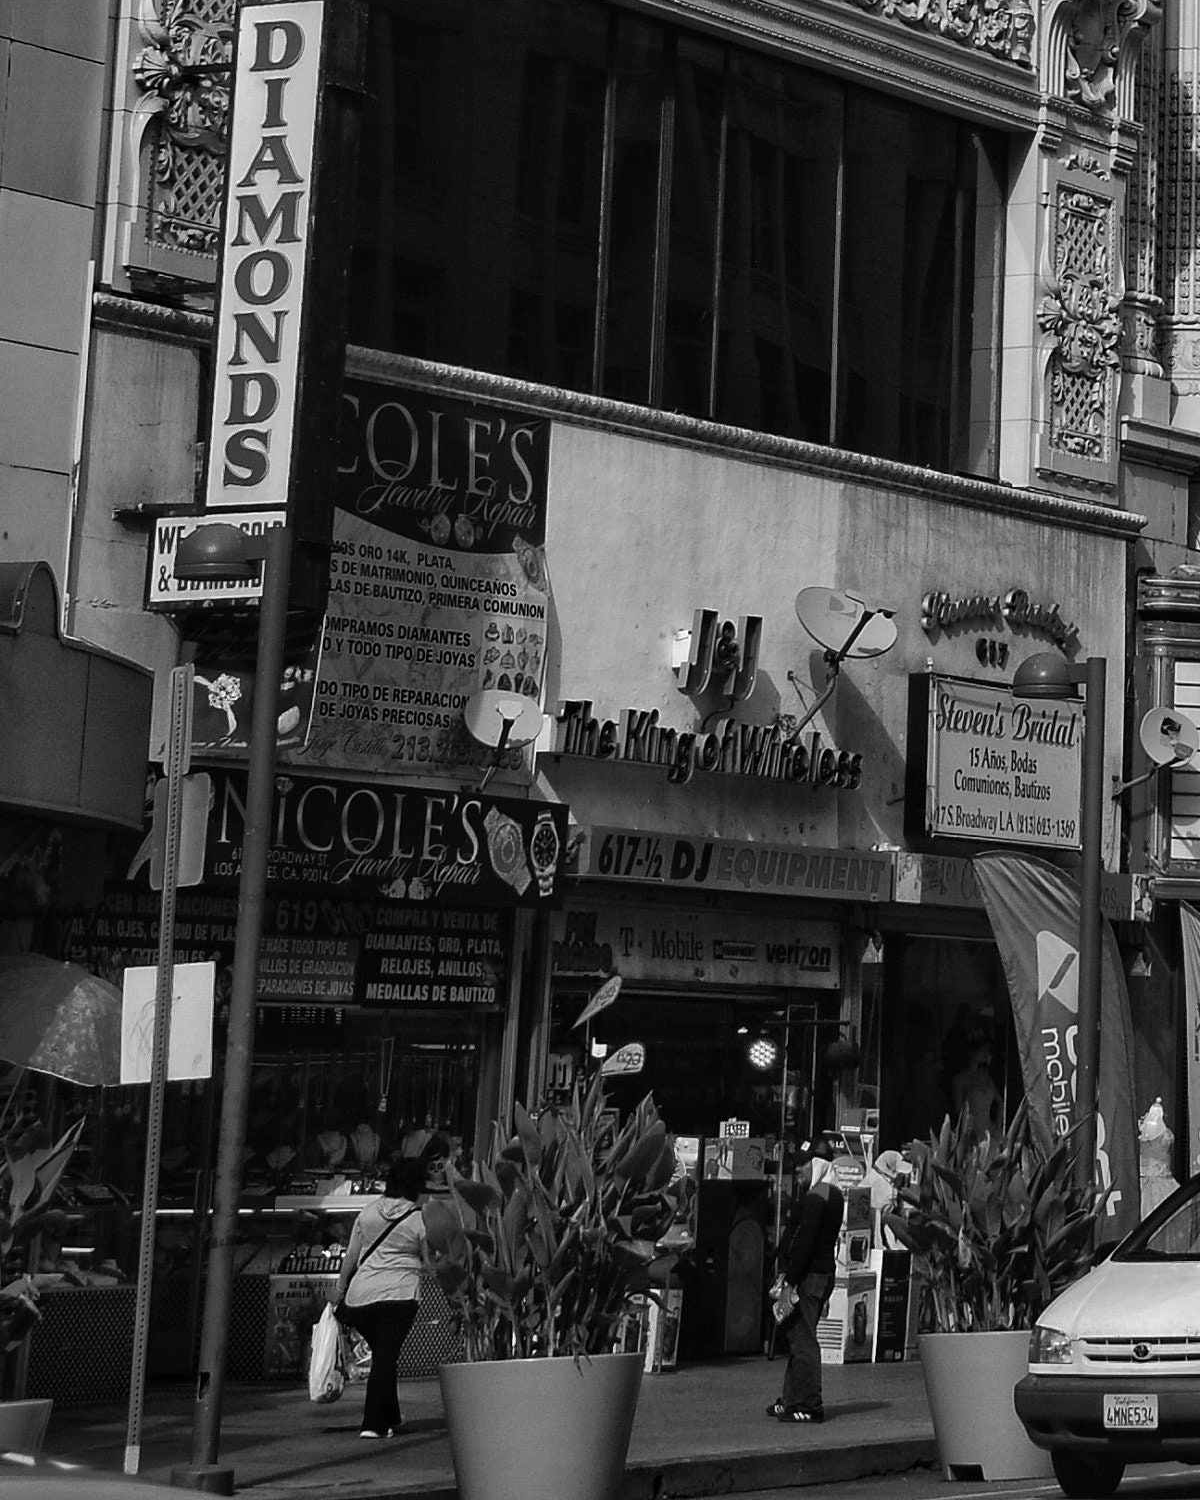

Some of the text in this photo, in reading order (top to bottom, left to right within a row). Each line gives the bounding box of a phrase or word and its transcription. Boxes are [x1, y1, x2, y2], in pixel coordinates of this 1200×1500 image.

[223, 20, 305, 488] DIAMONDS
[459, 477, 537, 539] Repair
[360, 544, 383, 560] ORO
[417, 552, 456, 572] PLATA,
[342, 561, 357, 576] DE
[360, 563, 437, 589] MATRIMONIO,
[441, 573, 517, 597] QUINCEAÑOS
[355, 581, 370, 597] DE
[373, 583, 425, 605] BAUTIZO,
[429, 592, 480, 611] PRIMERA
[484, 598, 545, 619] COMUNION
[398, 624, 471, 647] DIAMANTES
[336, 638, 344, 652] Y
[348, 640, 381, 657] TODO
[385, 644, 412, 661] TIPO
[417, 648, 433, 663] DE
[436, 650, 475, 668] JOYAS
[342, 683, 369, 700] TIPO
[373, 686, 389, 702] DE
[320, 702, 450, 729] DE JOYAS PRECIOSAS
[936, 693, 1077, 750] Steven's Bridal
[557, 700, 618, 759] The
[620, 708, 697, 784] King
[969, 747, 1037, 774] 15 Años, Bodas
[954, 769, 1051, 800] Comuniones, Bautizos
[956, 806, 998, 834] Broadway
[215, 861, 233, 876] LOS
[417, 844, 483, 897] Repair
[670, 840, 713, 883] DJ
[716, 847, 886, 893] EQUIPMENT
[276, 901, 317, 931] 619
[376, 907, 428, 928] COMPRA
[443, 910, 480, 930] VENTA
[484, 912, 498, 931] DE
[365, 933, 504, 959] DIAMANTES, ORO, PLATA,
[651, 930, 704, 962] Mobile
[766, 938, 832, 968] verizon
[289, 960, 300, 974] DE
[380, 956, 486, 981] RELOJES, ANILLOS,
[315, 980, 355, 997] DE JOYAS
[365, 983, 496, 1004] MEDALLAS DE BAUTIZO
[1041, 1026, 1070, 1137] mobile
[1107, 1406, 1154, 1424] 4MNE534
